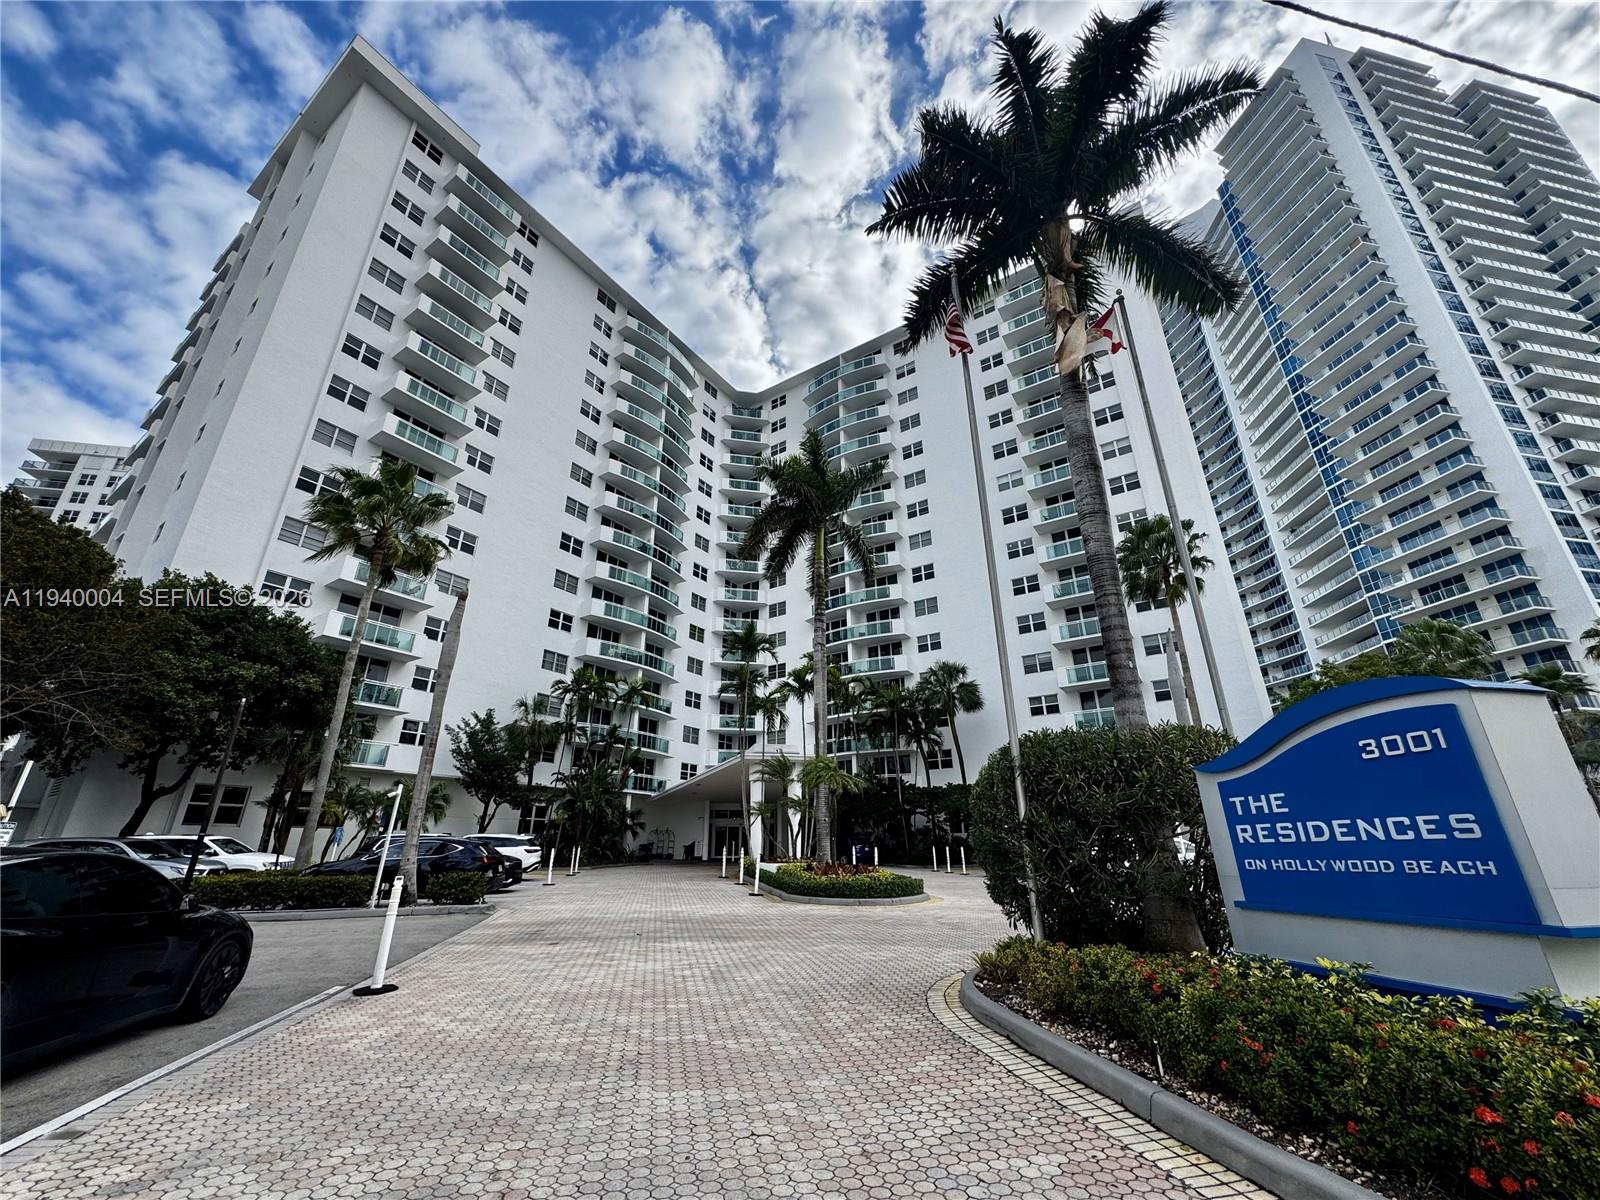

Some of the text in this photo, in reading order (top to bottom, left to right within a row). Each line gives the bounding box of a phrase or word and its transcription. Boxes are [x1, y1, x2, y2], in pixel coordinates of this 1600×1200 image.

[1358, 727, 1448, 760] 3001
[1229, 792, 1289, 816] THE
[1235, 813, 1483, 844] RESIDENCES
[1244, 858, 1498, 876] ON HOLLYWOOD BEACH
